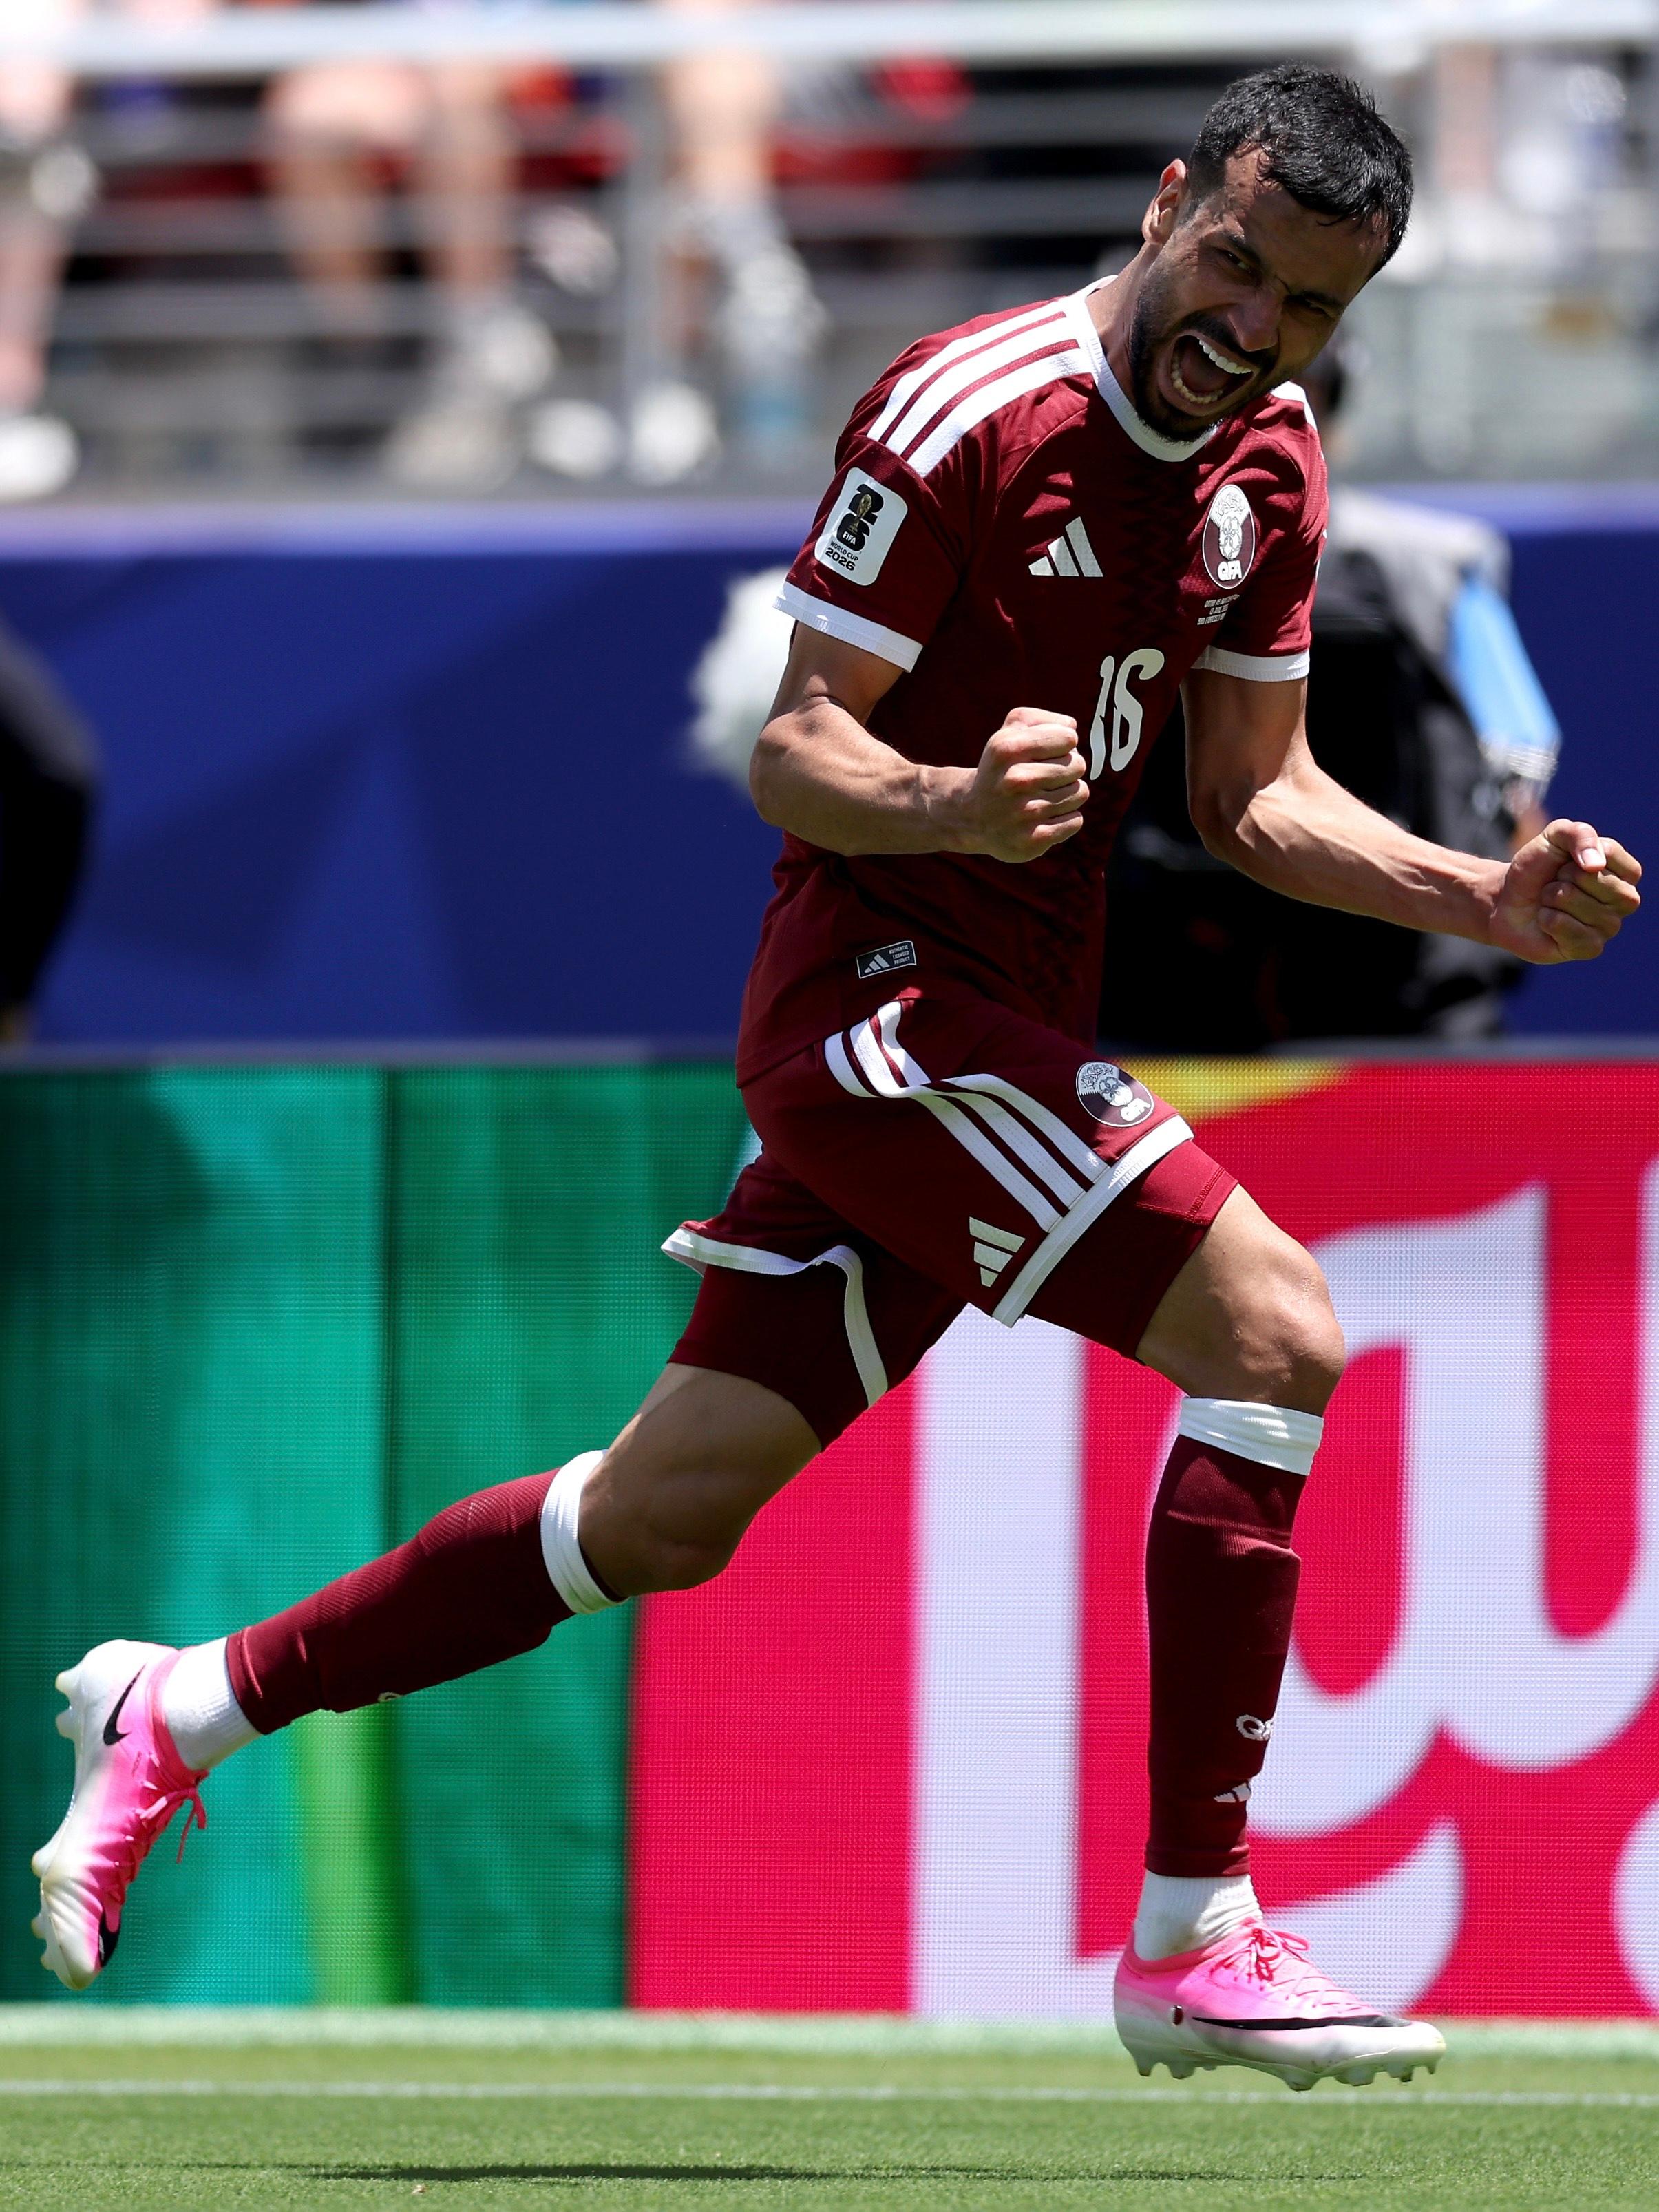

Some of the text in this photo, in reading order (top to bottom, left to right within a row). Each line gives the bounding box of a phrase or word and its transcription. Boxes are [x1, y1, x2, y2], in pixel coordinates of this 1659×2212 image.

[842, 531, 856, 545] FIFA
[825, 547, 856, 571] 2026
[830, 540, 859, 562] WORLD CUP
[1217, 560, 1243, 582] QFA
[1090, 648, 1165, 781] 16
[894, 956, 910, 965] PRODUCT
